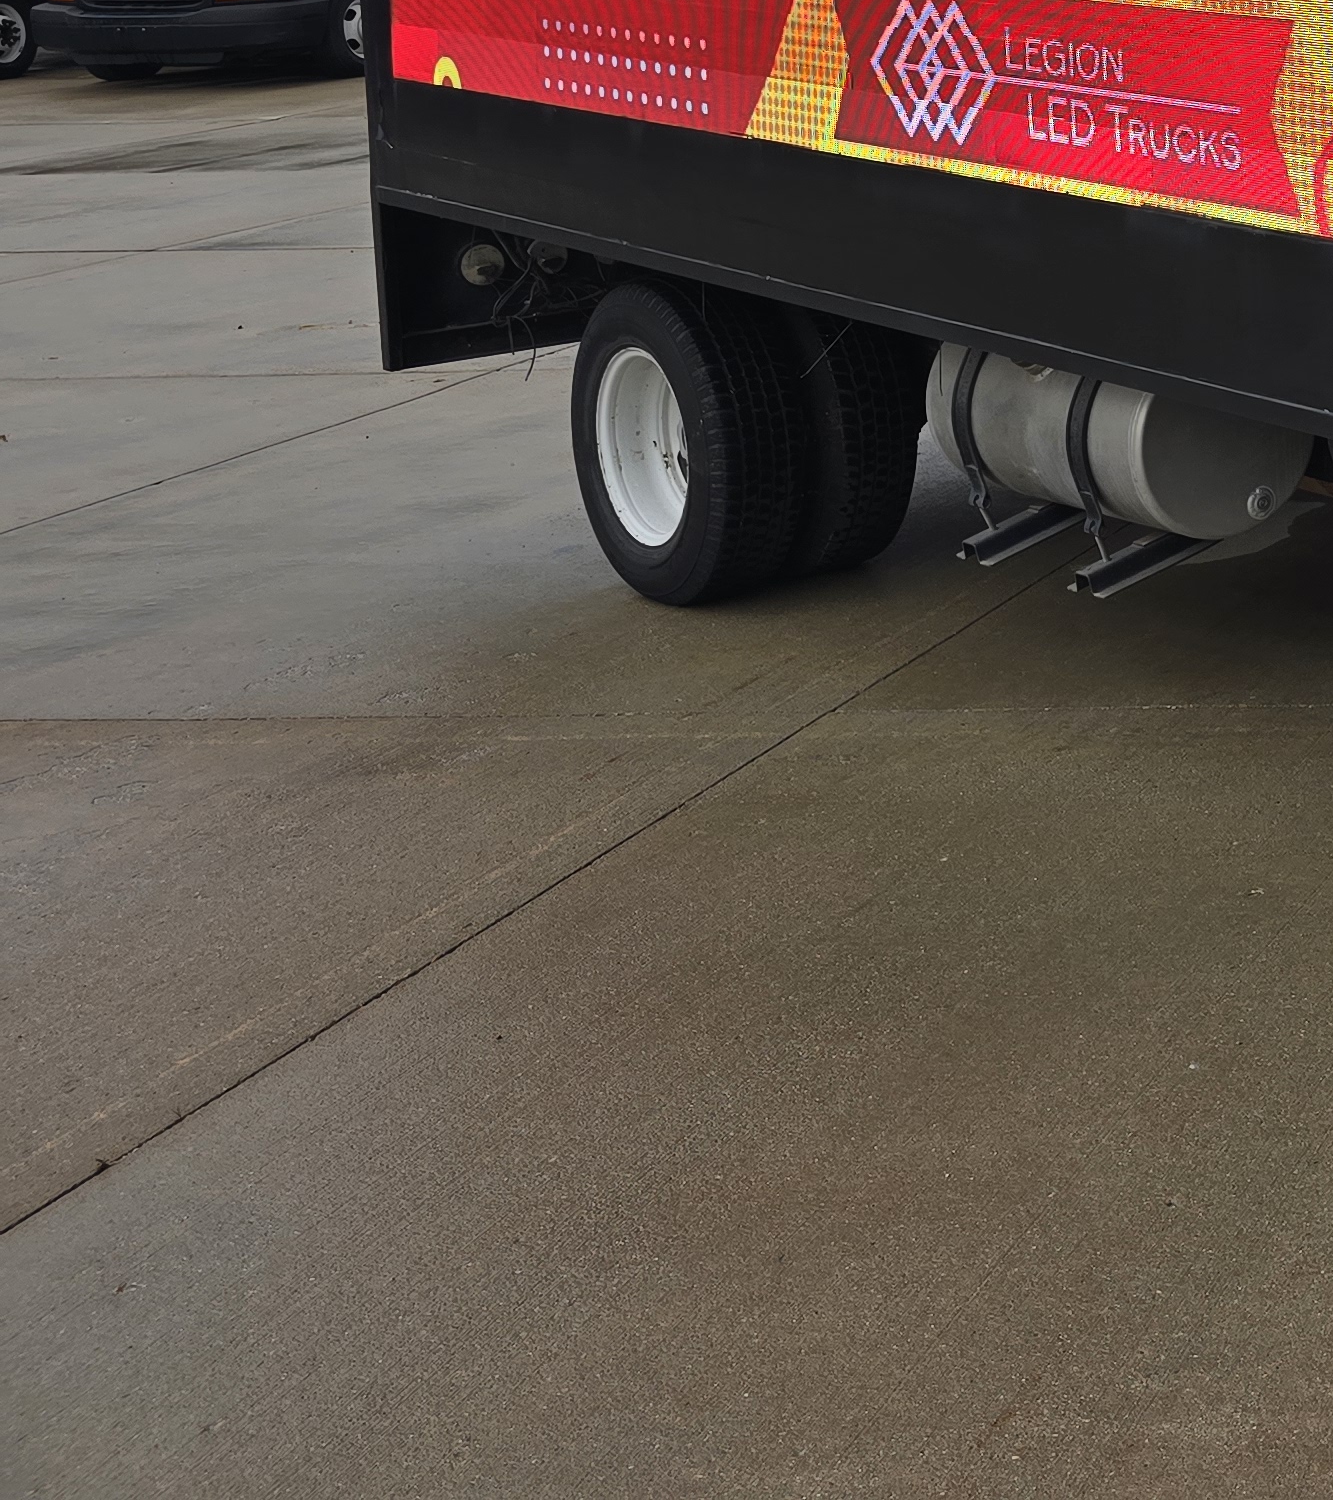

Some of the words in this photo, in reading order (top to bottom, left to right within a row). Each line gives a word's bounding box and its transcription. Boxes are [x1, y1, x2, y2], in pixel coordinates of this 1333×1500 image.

[1003, 26, 1126, 84] LEGION
[1026, 92, 1096, 148] LED
[1105, 104, 1243, 173] TRUCKS
